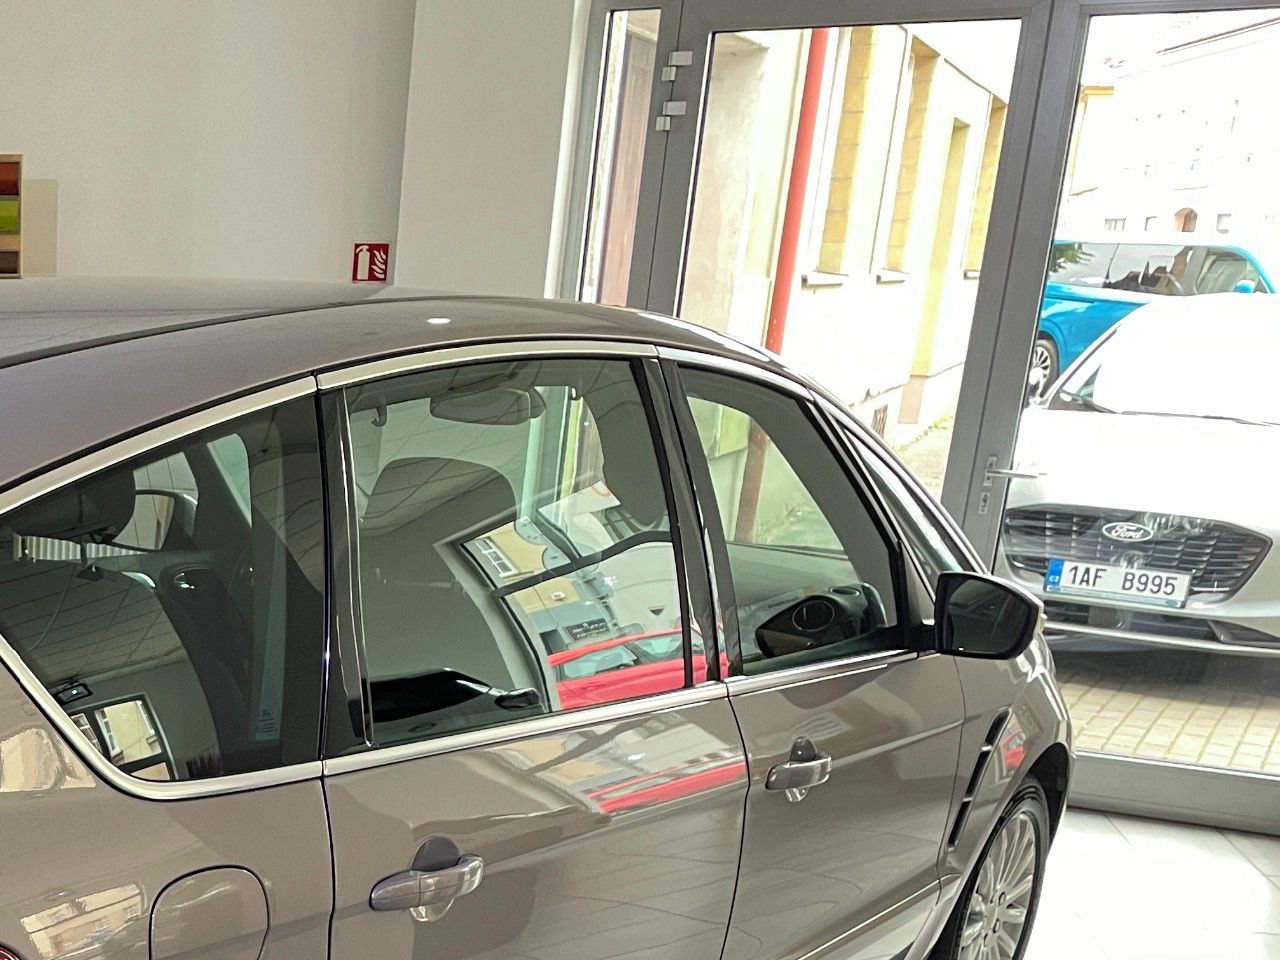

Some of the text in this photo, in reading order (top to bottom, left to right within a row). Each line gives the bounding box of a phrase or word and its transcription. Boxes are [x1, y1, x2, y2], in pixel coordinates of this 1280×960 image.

[1110, 522, 1145, 540] Ford
[1069, 565, 1178, 596] 1AF B995
